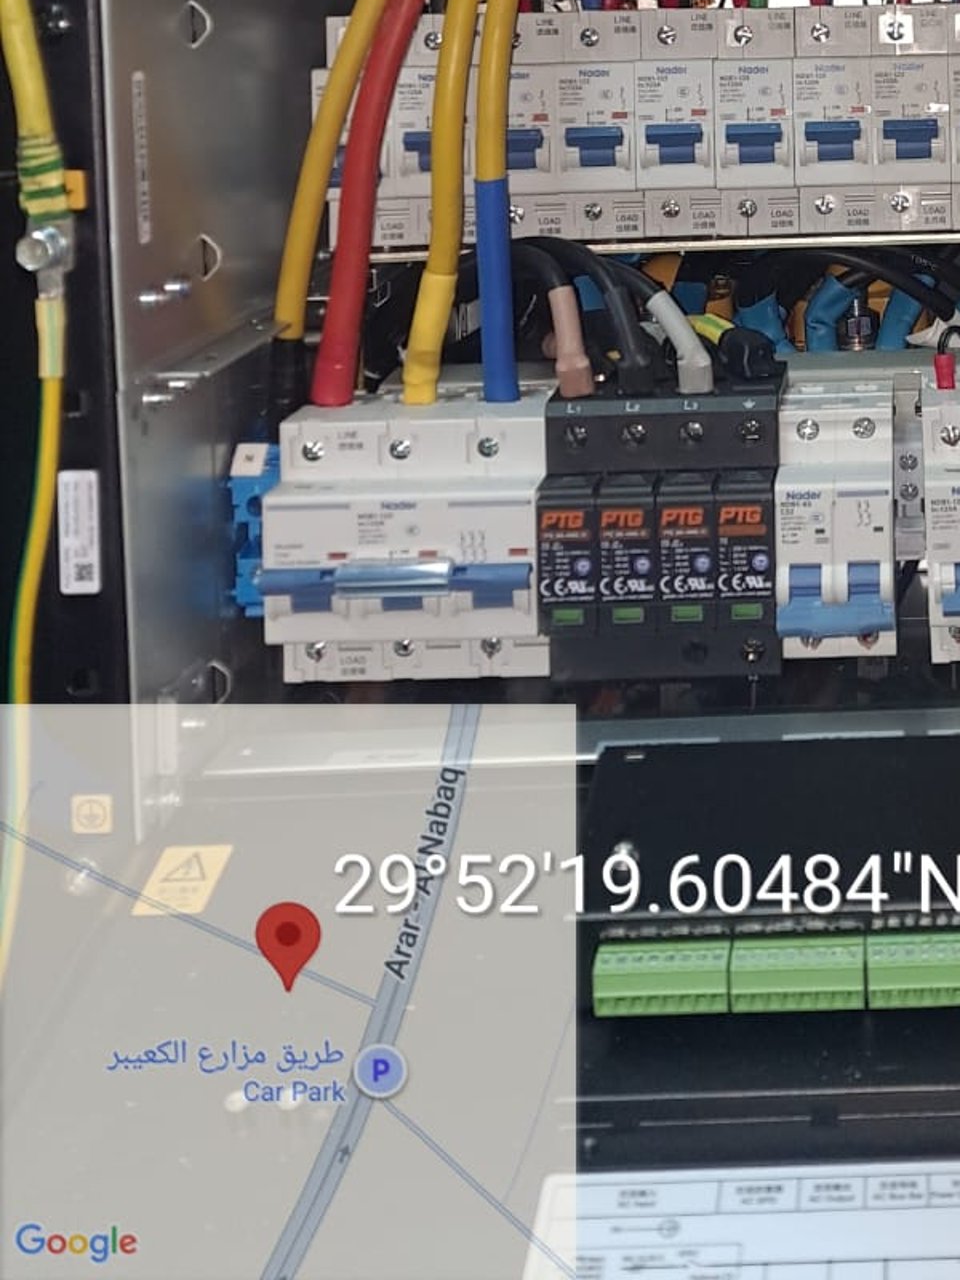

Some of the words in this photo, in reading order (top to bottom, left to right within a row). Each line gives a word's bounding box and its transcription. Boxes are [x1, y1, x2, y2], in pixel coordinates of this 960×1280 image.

[738, 66, 769, 74] Nader
[786, 491, 821, 500] Nader
[541, 510, 585, 529] PTG
[601, 509, 644, 527] PTG
[661, 507, 704, 526] PTG
[719, 506, 762, 524] PTG
